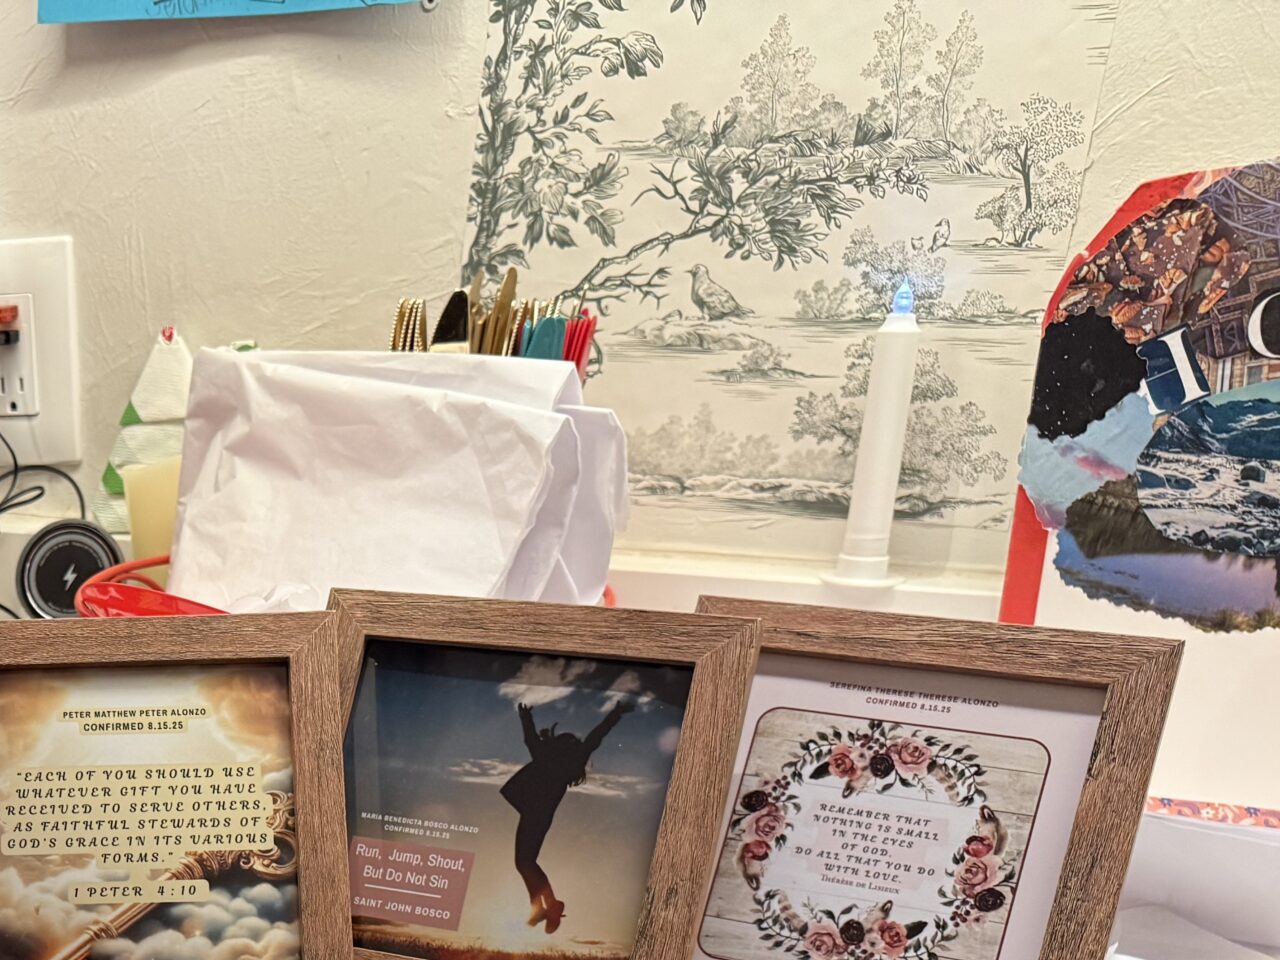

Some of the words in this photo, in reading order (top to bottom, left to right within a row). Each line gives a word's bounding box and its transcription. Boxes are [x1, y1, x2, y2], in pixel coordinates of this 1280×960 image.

[866, 697, 918, 710] CONFIRMED
[920, 704, 951, 713] 8.15.25
[875, 687, 915, 698] THERESE
[918, 692, 959, 703] THERESE
[961, 697, 999, 708] ALONZO
[63, 711, 91, 719] PETER
[94, 710, 137, 718] MATTHEW
[139, 709, 167, 717] PETER
[170, 708, 206, 716] ALONZO
[83, 722, 144, 732] CONFIRMED
[147, 721, 184, 730] 8.15.25
[75, 770, 97, 781] OF
[102, 769, 138, 780] YOU
[145, 767, 215, 780] SHOULD
[222, 766, 256, 777] USE
[15, 786, 113, 800] WHATEVER
[120, 785, 162, 797] GIFT
[168, 784, 203, 796] YOU
[210, 784, 257, 794] HAVE
[5, 804, 93, 816] RECEIVED
[100, 803, 120, 814] TO
[129, 801, 185, 813] SERVE
[820, 803, 890, 821] REMEMBER
[896, 815, 931, 827] THAT
[13, 822, 34, 832] AS
[41, 819, 130, 832] FAITHFUL
[137, 817, 232, 830] STEWARDS
[240, 817, 262, 827] OF
[361, 812, 382, 821] MARIA
[384, 815, 422, 826] BENEDICTA
[424, 820, 448, 830] BOSCO
[450, 823, 479, 834] ALONZO
[384, 824, 424, 835] CONFIRMED
[813, 814, 872, 830] NOTHING
[877, 824, 891, 833] IS
[896, 828, 939, 841] SMALL
[7, 837, 58, 849] GOD'S
[65, 836, 120, 848] GRACE
[126, 836, 146, 847] IN
[154, 834, 182, 846] ITS
[190, 833, 268, 846] VARIOUS
[832, 829, 846, 838] IN
[852, 832, 878, 843] THE
[882, 837, 914, 849] EYES
[841, 842, 858, 851] OF
[356, 843, 382, 859] Run,
[388, 849, 423, 867] Jump,
[427, 854, 465, 873] Shout,
[795, 846, 811, 856] DO
[817, 850, 840, 861] ALL
[846, 854, 881, 868] THAT
[885, 861, 911, 873] YOU
[917, 866, 935, 877] DO
[363, 865, 383, 879] But
[386, 868, 403, 881] Do
[405, 872, 426, 885] Not
[429, 875, 448, 889] Sin
[824, 863, 859, 876] WITH
[74, 888, 79, 898] 1
[87, 886, 144, 898] PETER
[353, 896, 383, 908] SAINT
[385, 901, 412, 913] JOHN
[415, 907, 450, 919] BOSCO
